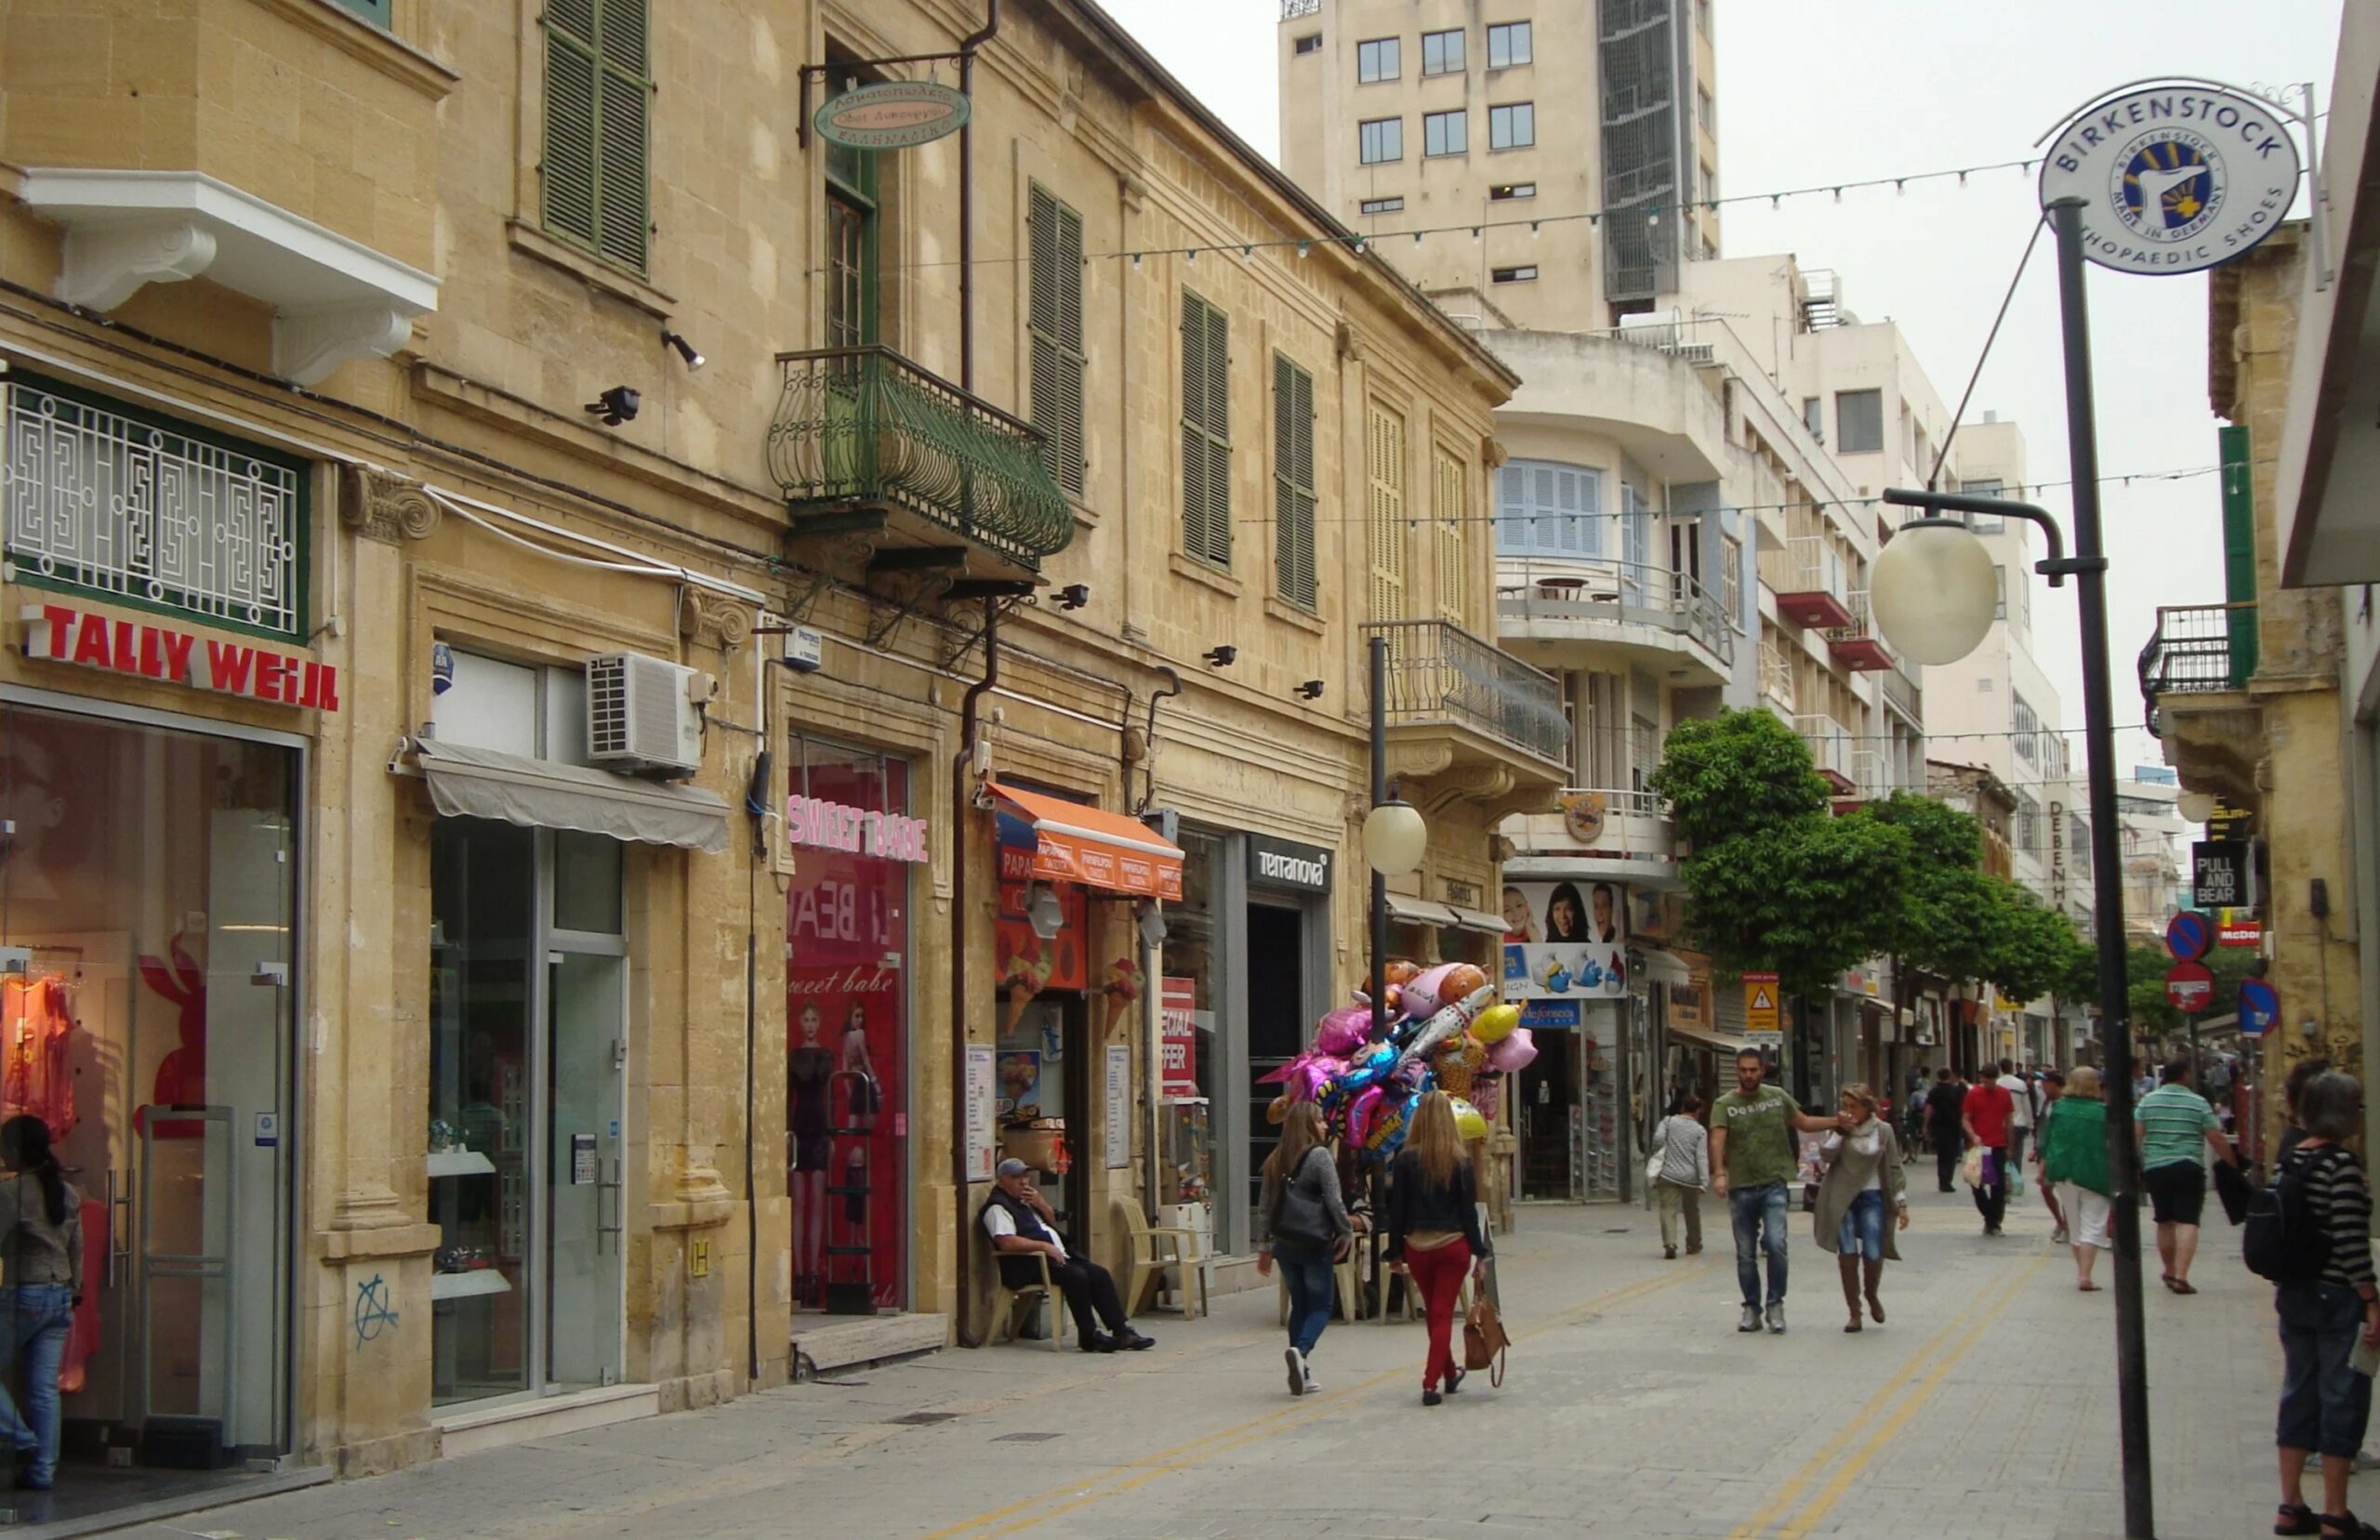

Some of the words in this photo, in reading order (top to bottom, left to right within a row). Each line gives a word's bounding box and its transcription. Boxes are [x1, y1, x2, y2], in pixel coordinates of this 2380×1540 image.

[2056, 96, 2283, 174] BIRKENSTOCK
[2117, 131, 2216, 169] BIRKENSTOCK
[2080, 223, 2211, 265] THOPAEDIC
[2224, 187, 2283, 247] SHOES
[2112, 190, 2139, 229] MADE
[2145, 227, 2162, 239] IN
[2171, 185, 2225, 239] GERMANY
[44, 604, 193, 681] TALLY
[788, 795, 864, 853] SWEET
[871, 810, 928, 862] BABE
[1003, 853, 1036, 879] PAPA
[2050, 800, 2066, 914] DEBENHA
[2197, 858, 2234, 873] PULL
[2197, 888, 2235, 902] BEAR
[2205, 873, 2235, 888] AND
[788, 970, 839, 994] weet
[840, 966, 892, 994] babe
[1162, 1010, 1192, 1037] ECIAL
